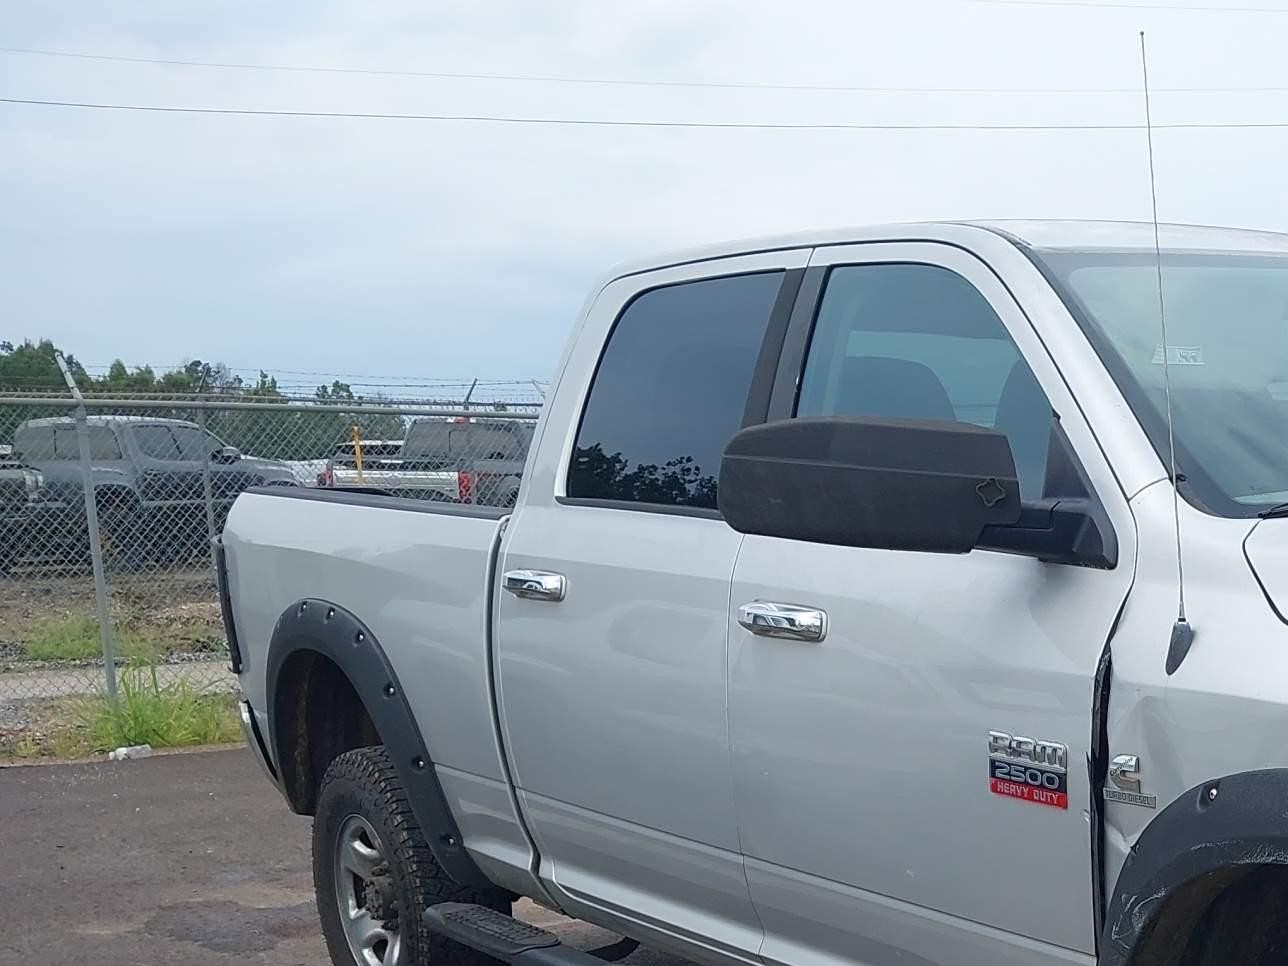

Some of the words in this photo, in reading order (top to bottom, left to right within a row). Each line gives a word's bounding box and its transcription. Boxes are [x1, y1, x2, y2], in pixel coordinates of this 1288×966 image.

[988, 730, 1067, 767] RAM
[995, 762, 1059, 789] 2500
[997, 781, 1029, 798] HEAVY
[1033, 789, 1059, 804] DUTY
